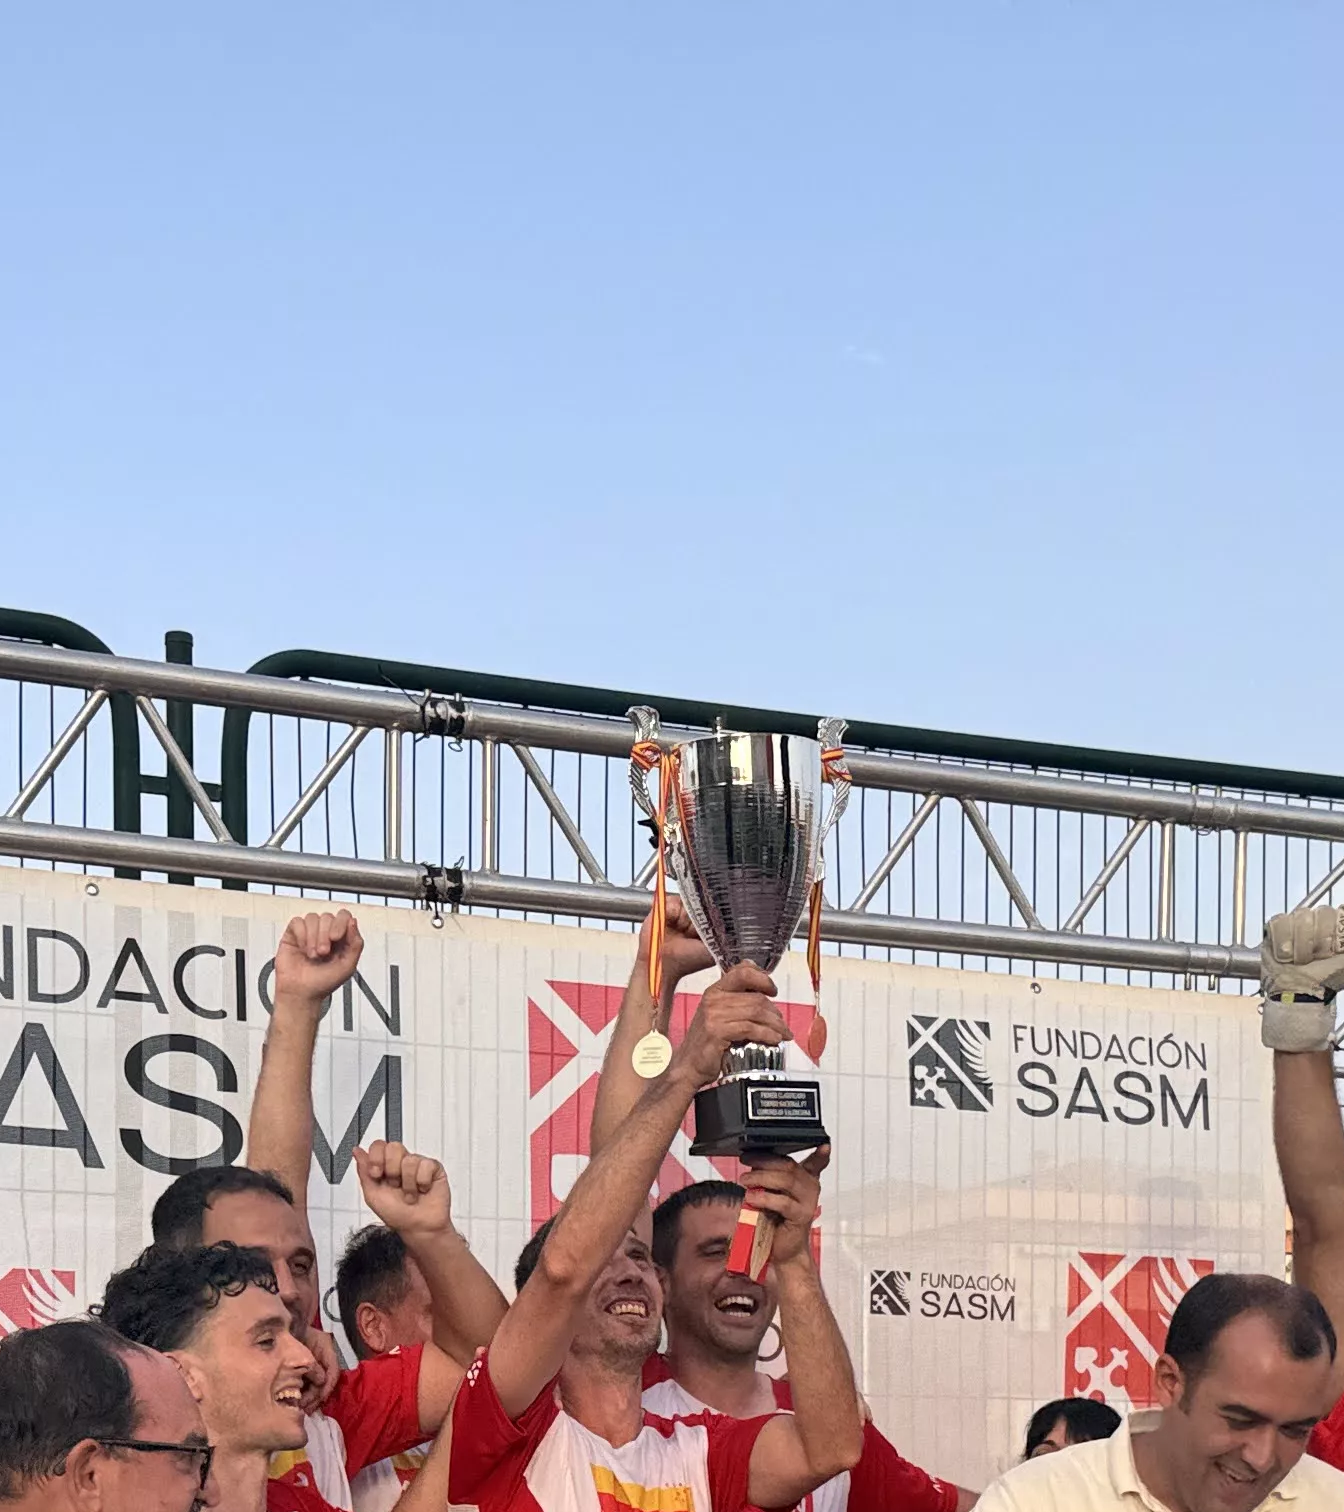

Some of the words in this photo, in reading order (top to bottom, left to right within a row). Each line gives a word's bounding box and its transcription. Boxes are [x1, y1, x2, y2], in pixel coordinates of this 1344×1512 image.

[1013, 1024, 1208, 1071] FUNDACIÓN
[1016, 1061, 1211, 1131] SASM
[920, 1272, 1016, 1293] FUNDACIÓN
[920, 1291, 1015, 1322] SASM
